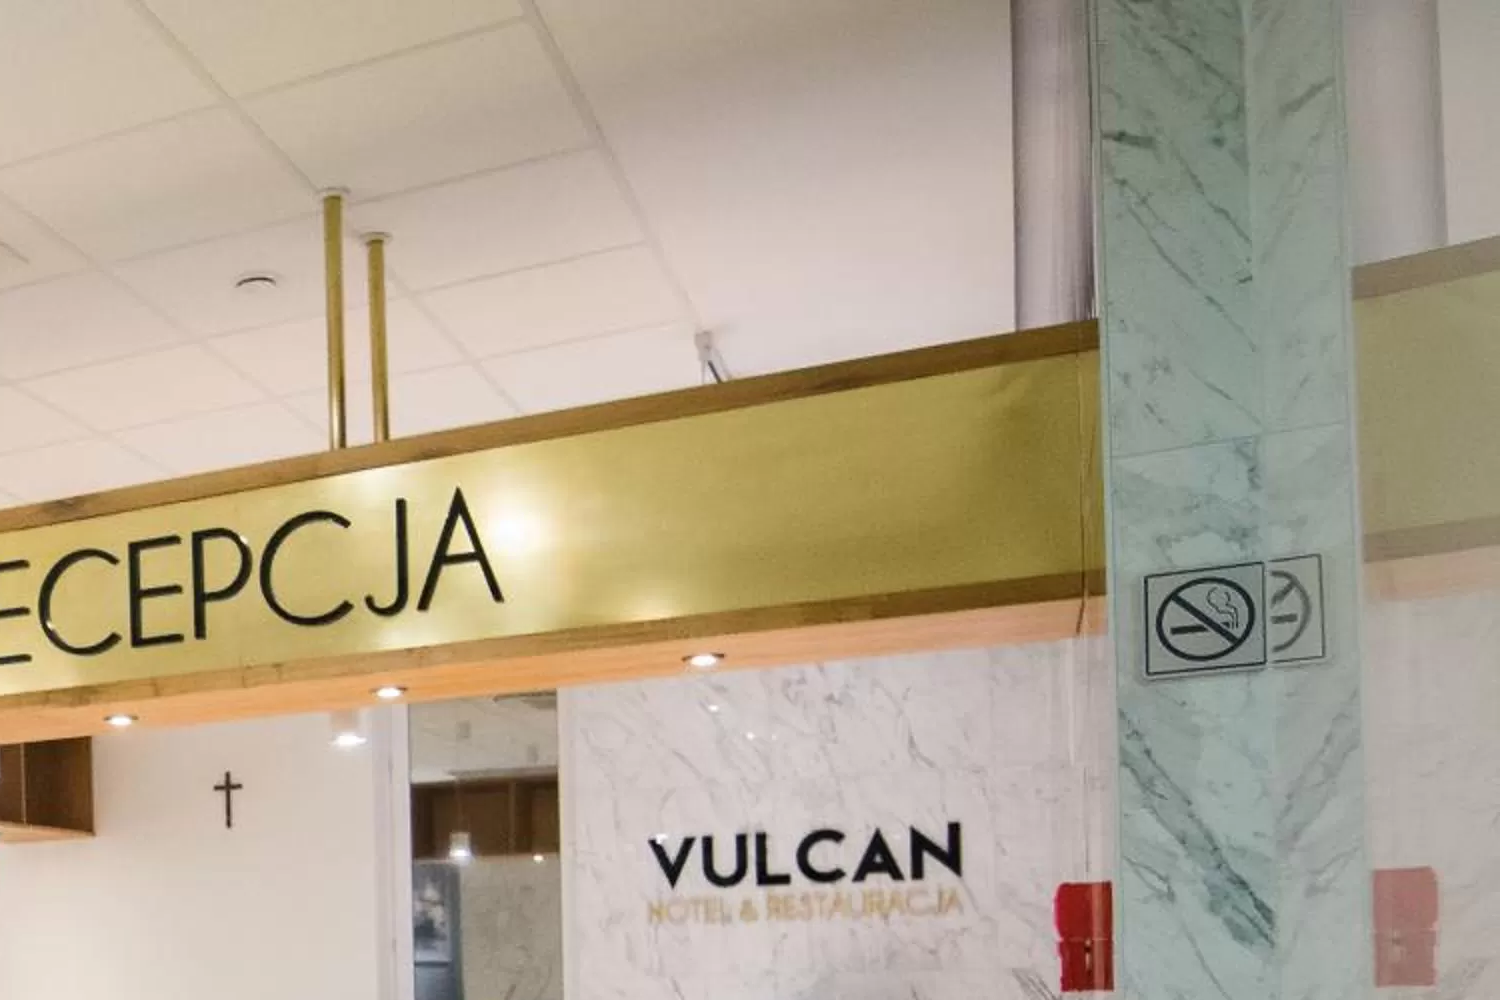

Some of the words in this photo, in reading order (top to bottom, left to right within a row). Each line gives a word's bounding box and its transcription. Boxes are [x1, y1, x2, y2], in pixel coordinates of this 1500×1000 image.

[647, 821, 963, 890] VULCAN
[647, 897, 732, 926] HOTEL
[739, 897, 760, 924] &
